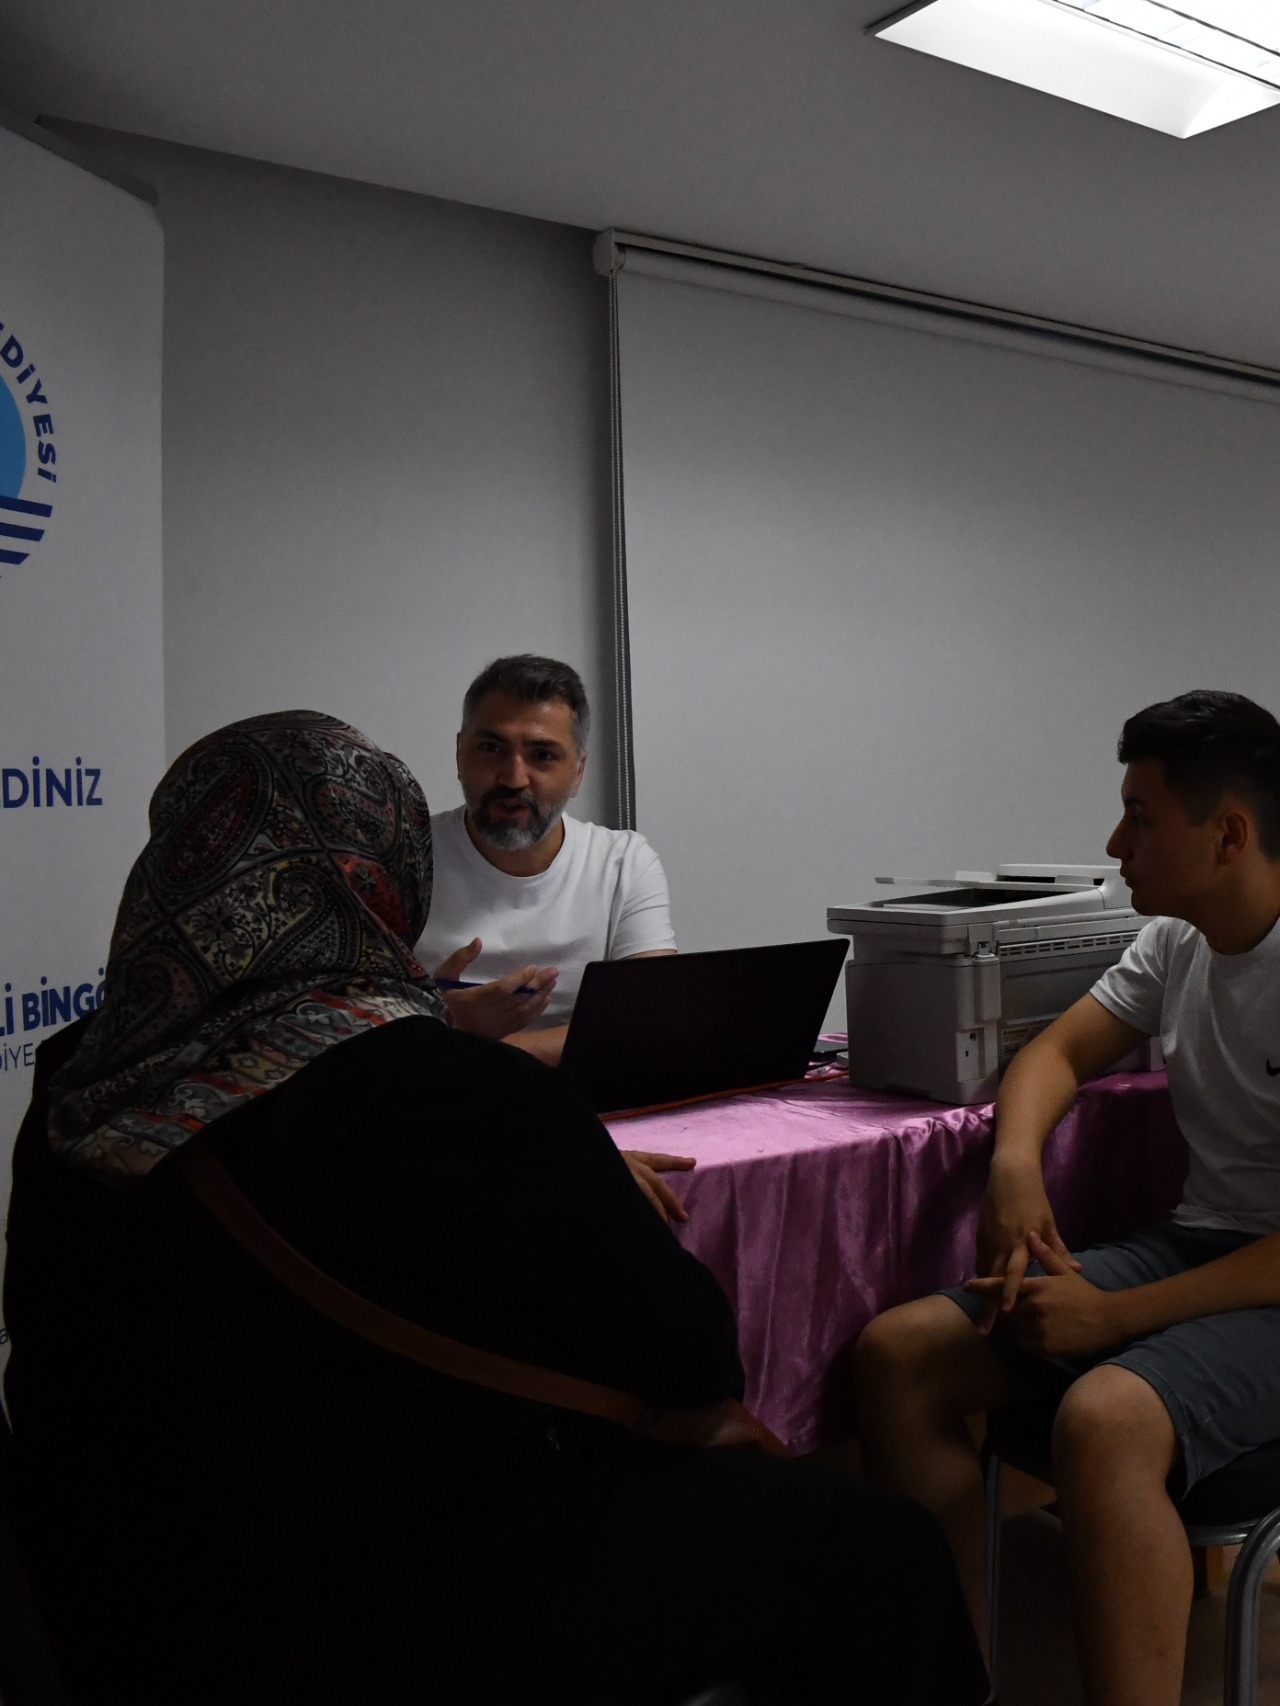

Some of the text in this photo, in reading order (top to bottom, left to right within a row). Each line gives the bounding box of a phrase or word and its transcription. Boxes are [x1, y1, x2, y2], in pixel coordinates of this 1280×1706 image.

[0, 322, 56, 483] DİYESİ
[1, 756, 103, 809] DİNİZ
[0, 1043, 34, 1072] İYE
